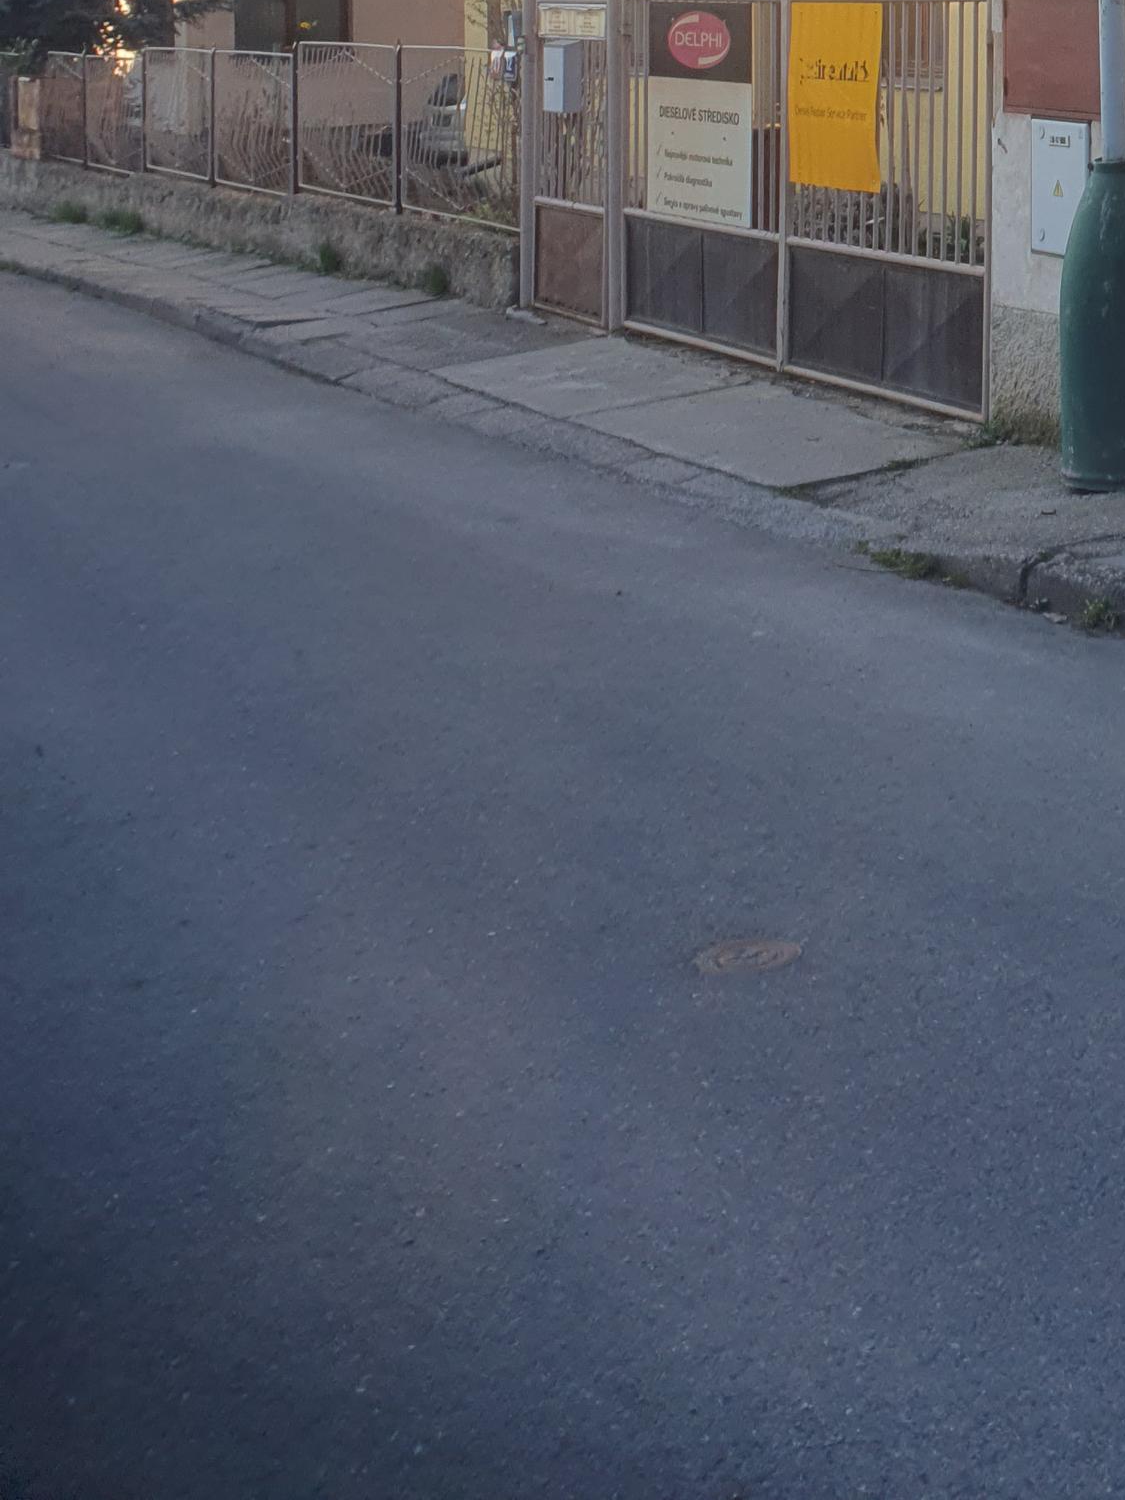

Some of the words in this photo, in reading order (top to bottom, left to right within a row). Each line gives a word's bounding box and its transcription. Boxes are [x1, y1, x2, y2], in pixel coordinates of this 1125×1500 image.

[674, 31, 723, 48] DELPHI
[659, 105, 697, 121] DIESELOVÉ
[698, 108, 740, 126] STŘEDISKO
